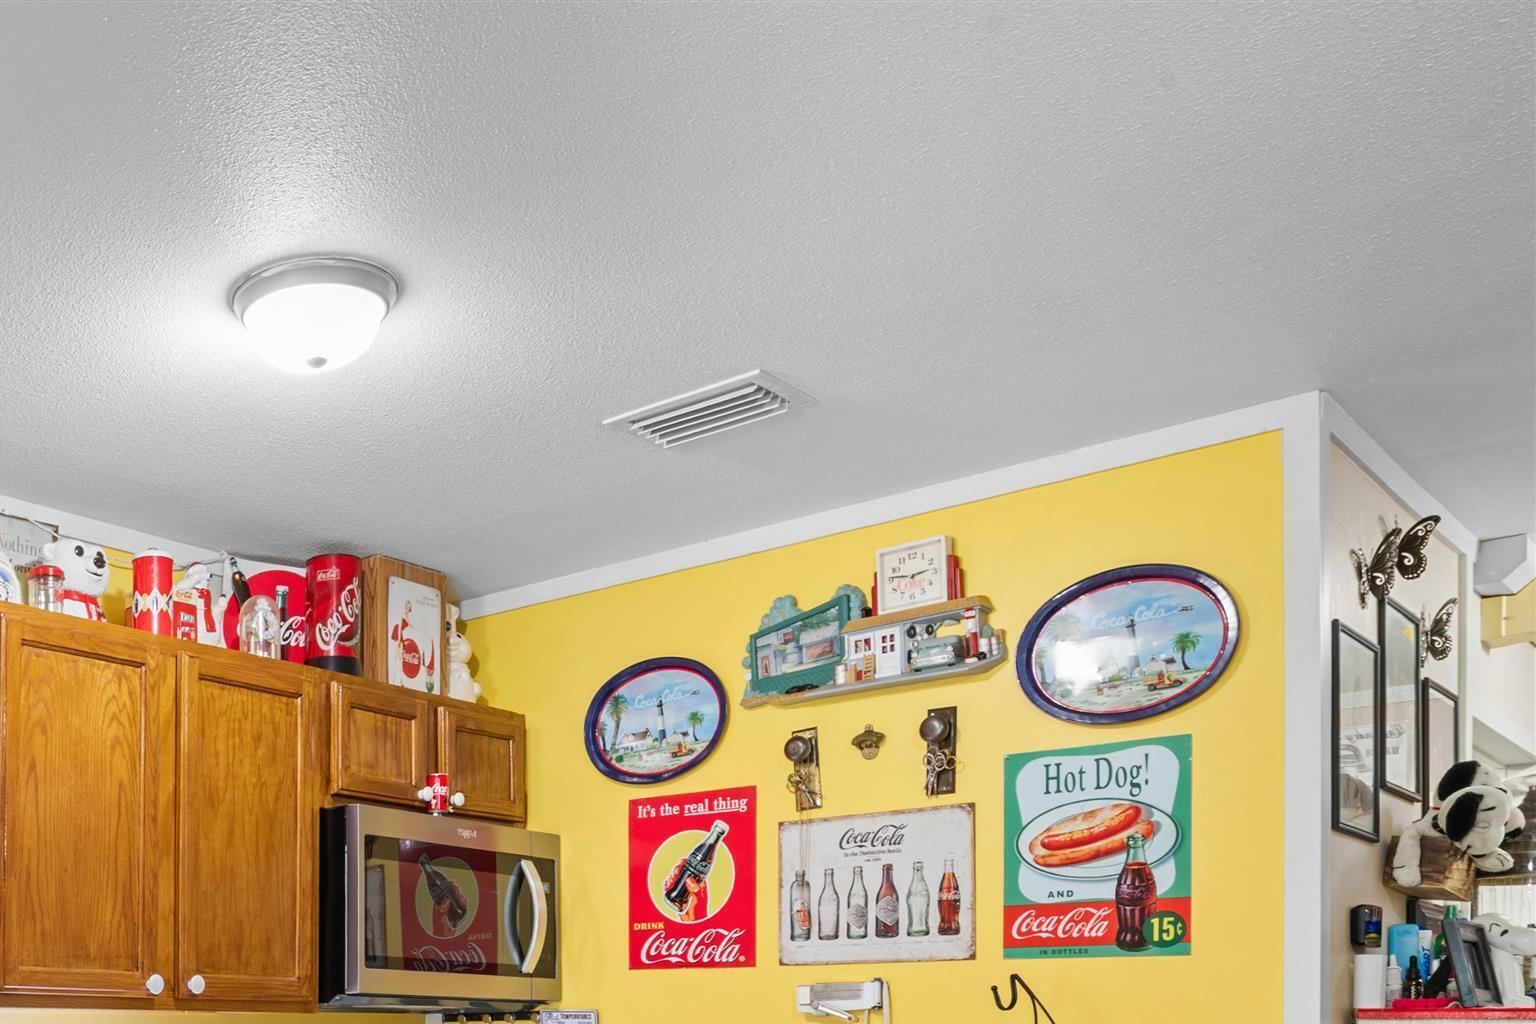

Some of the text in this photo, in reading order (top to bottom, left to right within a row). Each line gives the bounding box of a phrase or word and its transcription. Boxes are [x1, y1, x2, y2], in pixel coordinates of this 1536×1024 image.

[1043, 753, 1150, 797] Hot Dog!
[637, 797, 749, 818] It's the real thing
[839, 823, 908, 850] Coca-Cola
[1047, 890, 1074, 899] AND
[634, 921, 664, 931] DRINK
[1012, 906, 1114, 940] Coca-Cola
[1151, 916, 1183, 942] 15¢
[640, 928, 746, 965] Coca-Cola
[1051, 947, 1089, 956] BOTTLES
